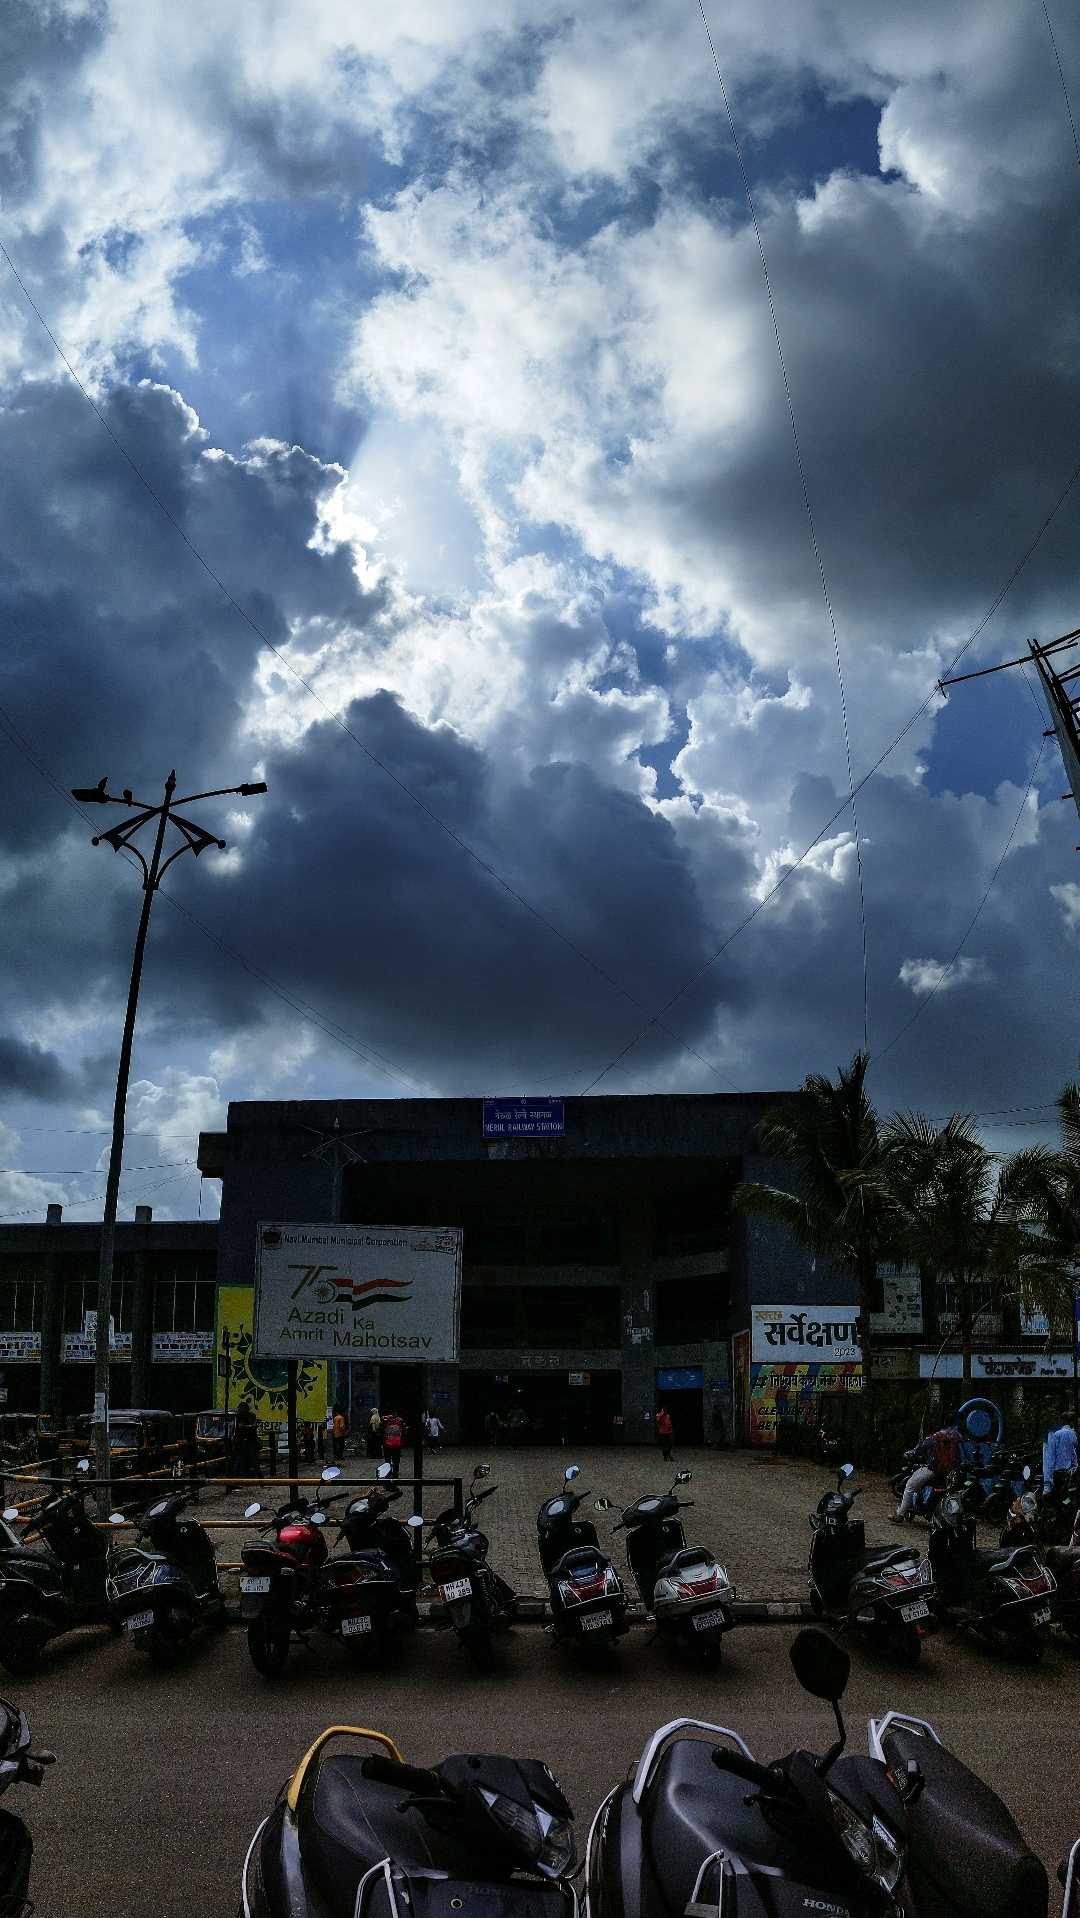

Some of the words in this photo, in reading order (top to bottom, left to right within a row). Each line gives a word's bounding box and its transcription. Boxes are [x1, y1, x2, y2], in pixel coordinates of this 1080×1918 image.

[507, 1122, 535, 1132] RAILWAY
[536, 1122, 563, 1132] STATION
[284, 1235, 299, 1245] Navi
[301, 1235, 328, 1246] Mumbai
[330, 1235, 363, 1248] Municipal
[365, 1236, 407, 1249] Corporation
[287, 1307, 344, 1325] Azadi
[352, 1316, 375, 1331] Ka
[279, 1326, 324, 1341] Amrit
[333, 1330, 433, 1350] Mahotsav
[764, 1312, 858, 1348] सर्वेक्षण
[833, 1347, 856, 1358] 2023
